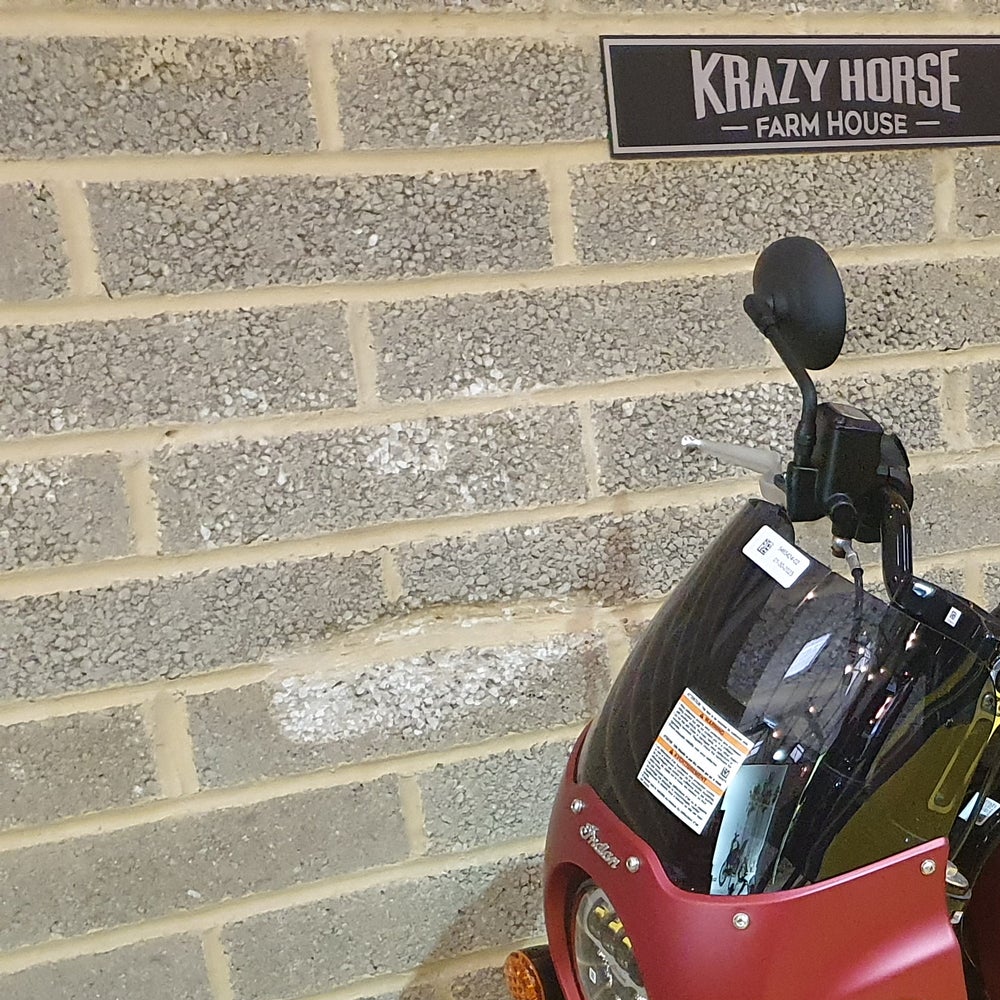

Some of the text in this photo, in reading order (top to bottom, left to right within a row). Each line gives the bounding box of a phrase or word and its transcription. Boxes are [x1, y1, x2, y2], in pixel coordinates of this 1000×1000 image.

[690, 48, 961, 119] KRAZY HORSE
[756, 110, 908, 138] FARM HOUSE
